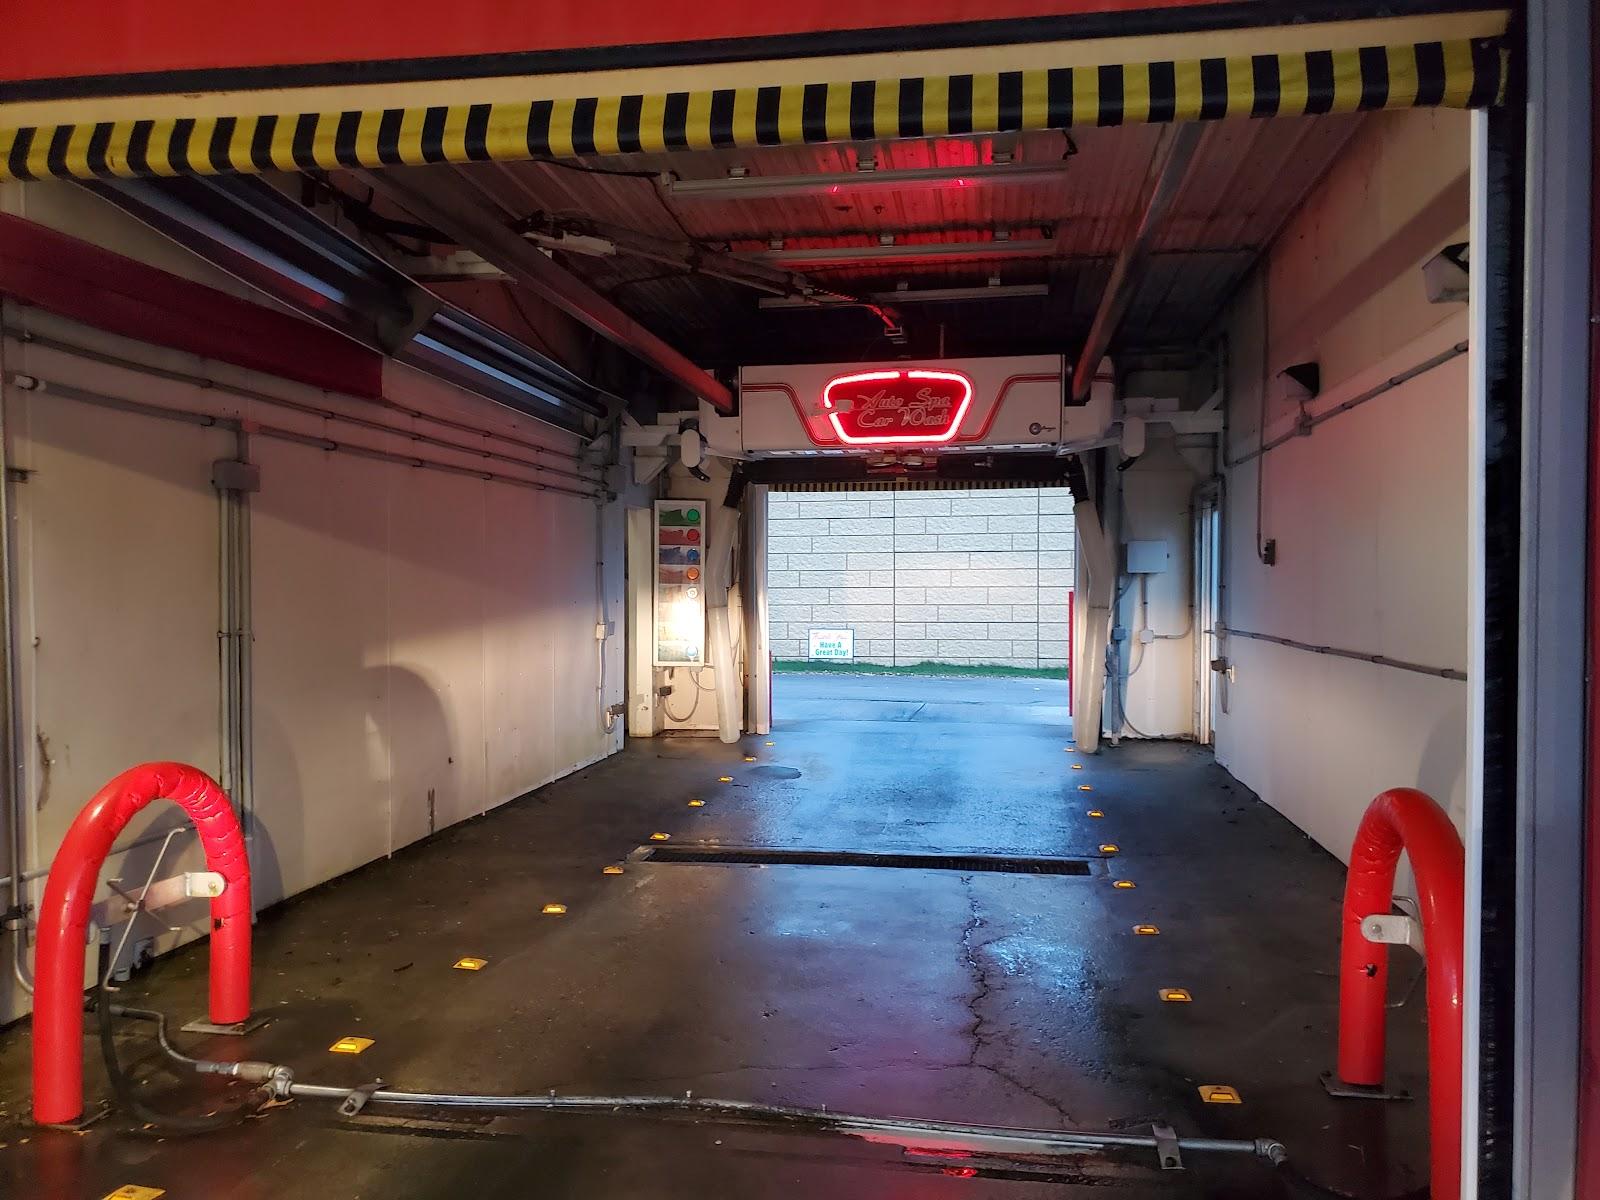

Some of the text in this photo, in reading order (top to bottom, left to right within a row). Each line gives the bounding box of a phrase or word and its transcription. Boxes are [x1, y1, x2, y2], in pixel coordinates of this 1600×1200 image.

[857, 388, 951, 410] Auto Spa
[857, 407, 950, 428] Car Wash
